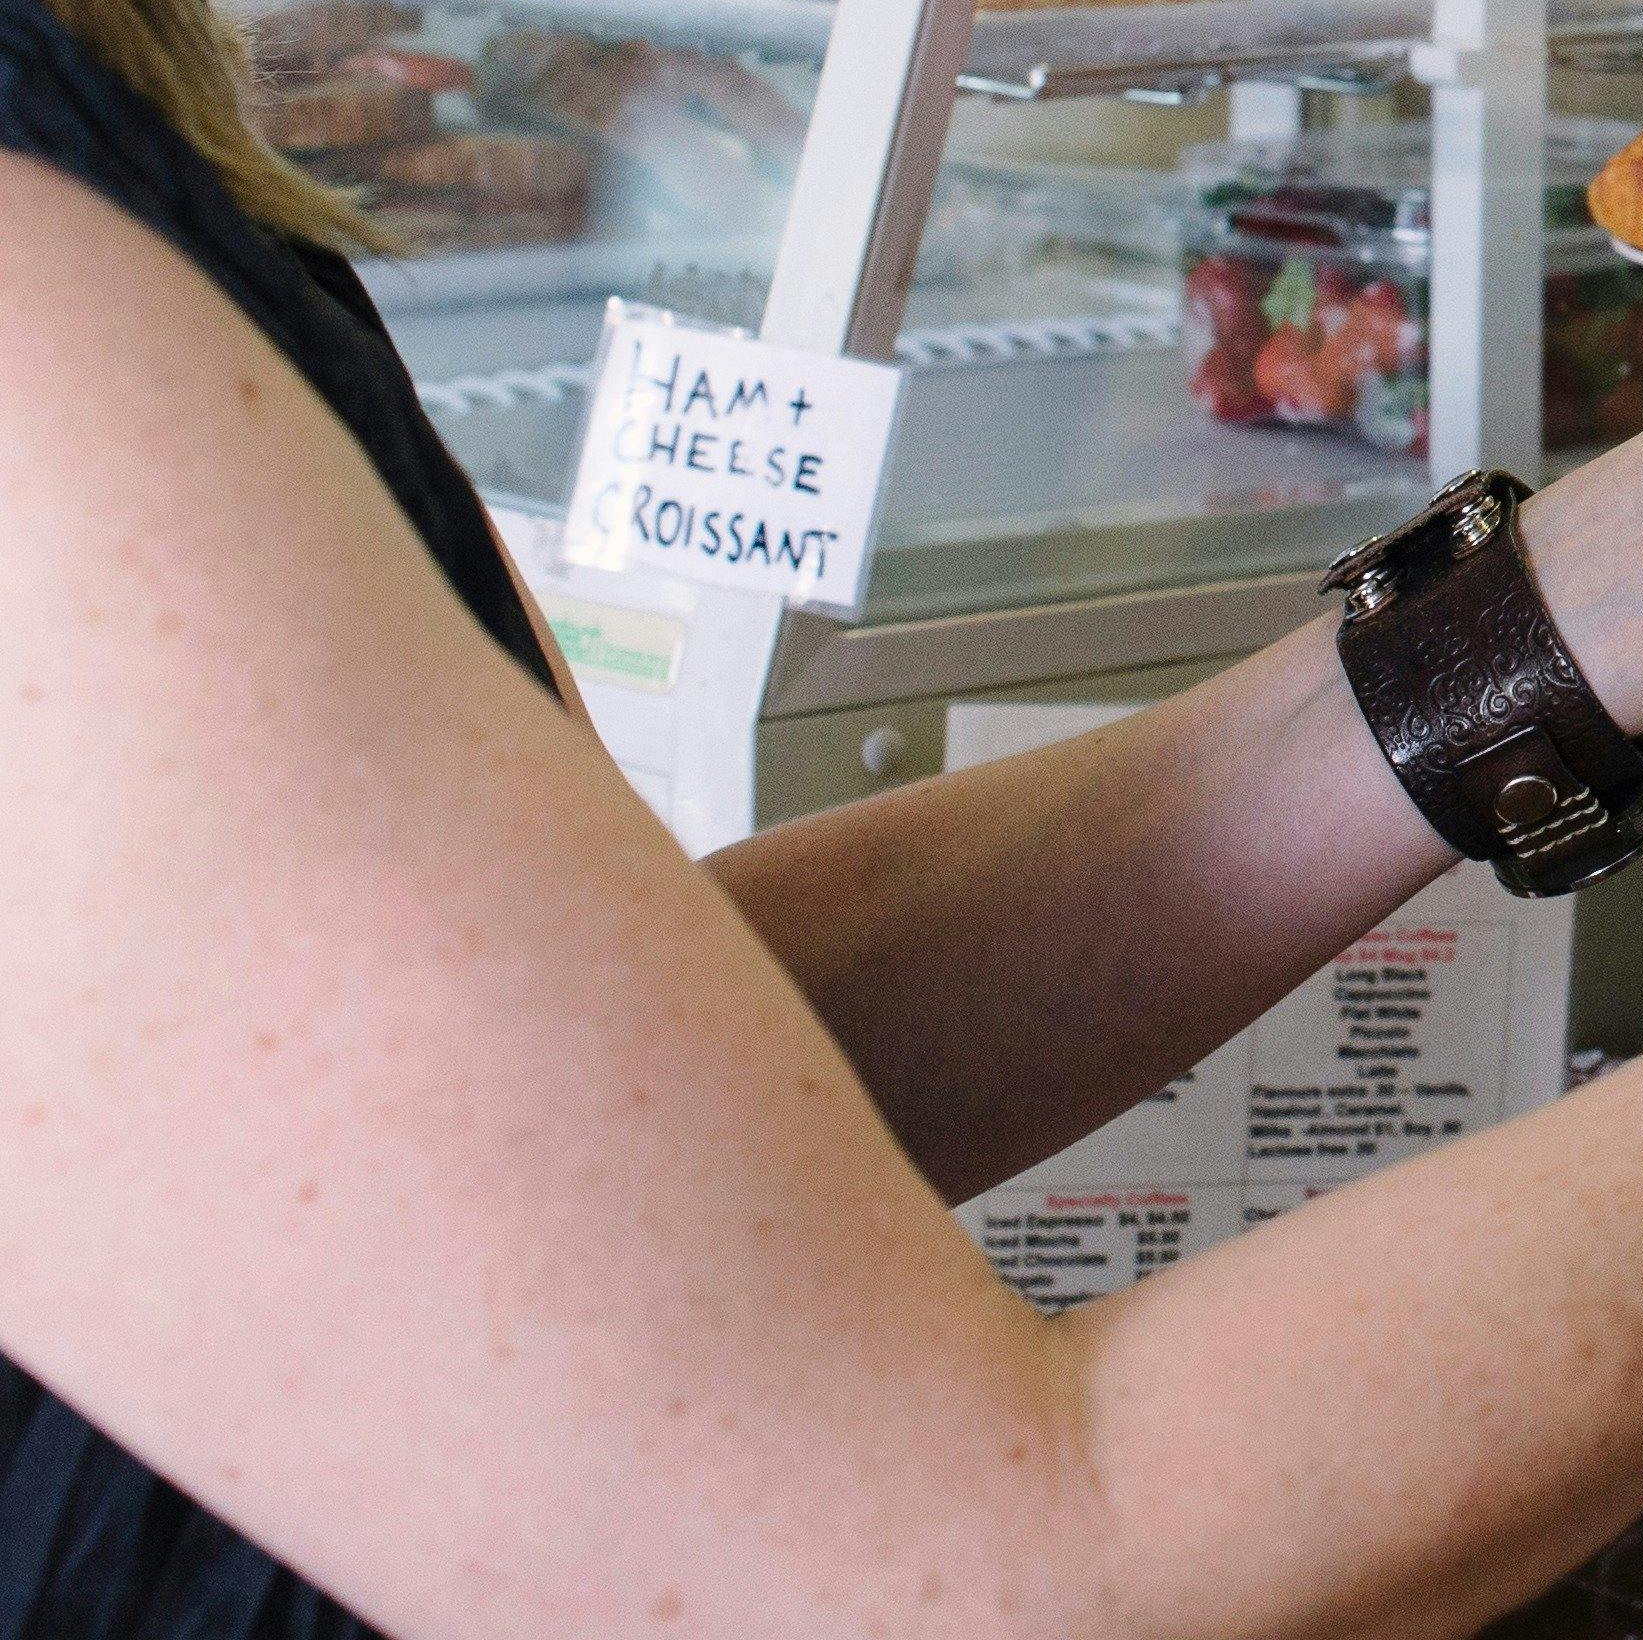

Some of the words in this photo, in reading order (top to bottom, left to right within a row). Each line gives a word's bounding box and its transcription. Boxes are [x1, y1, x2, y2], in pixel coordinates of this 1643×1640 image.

[621, 338, 768, 420] HAM
[614, 416, 824, 496] CHEESE
[592, 479, 838, 579] CROISSANT
